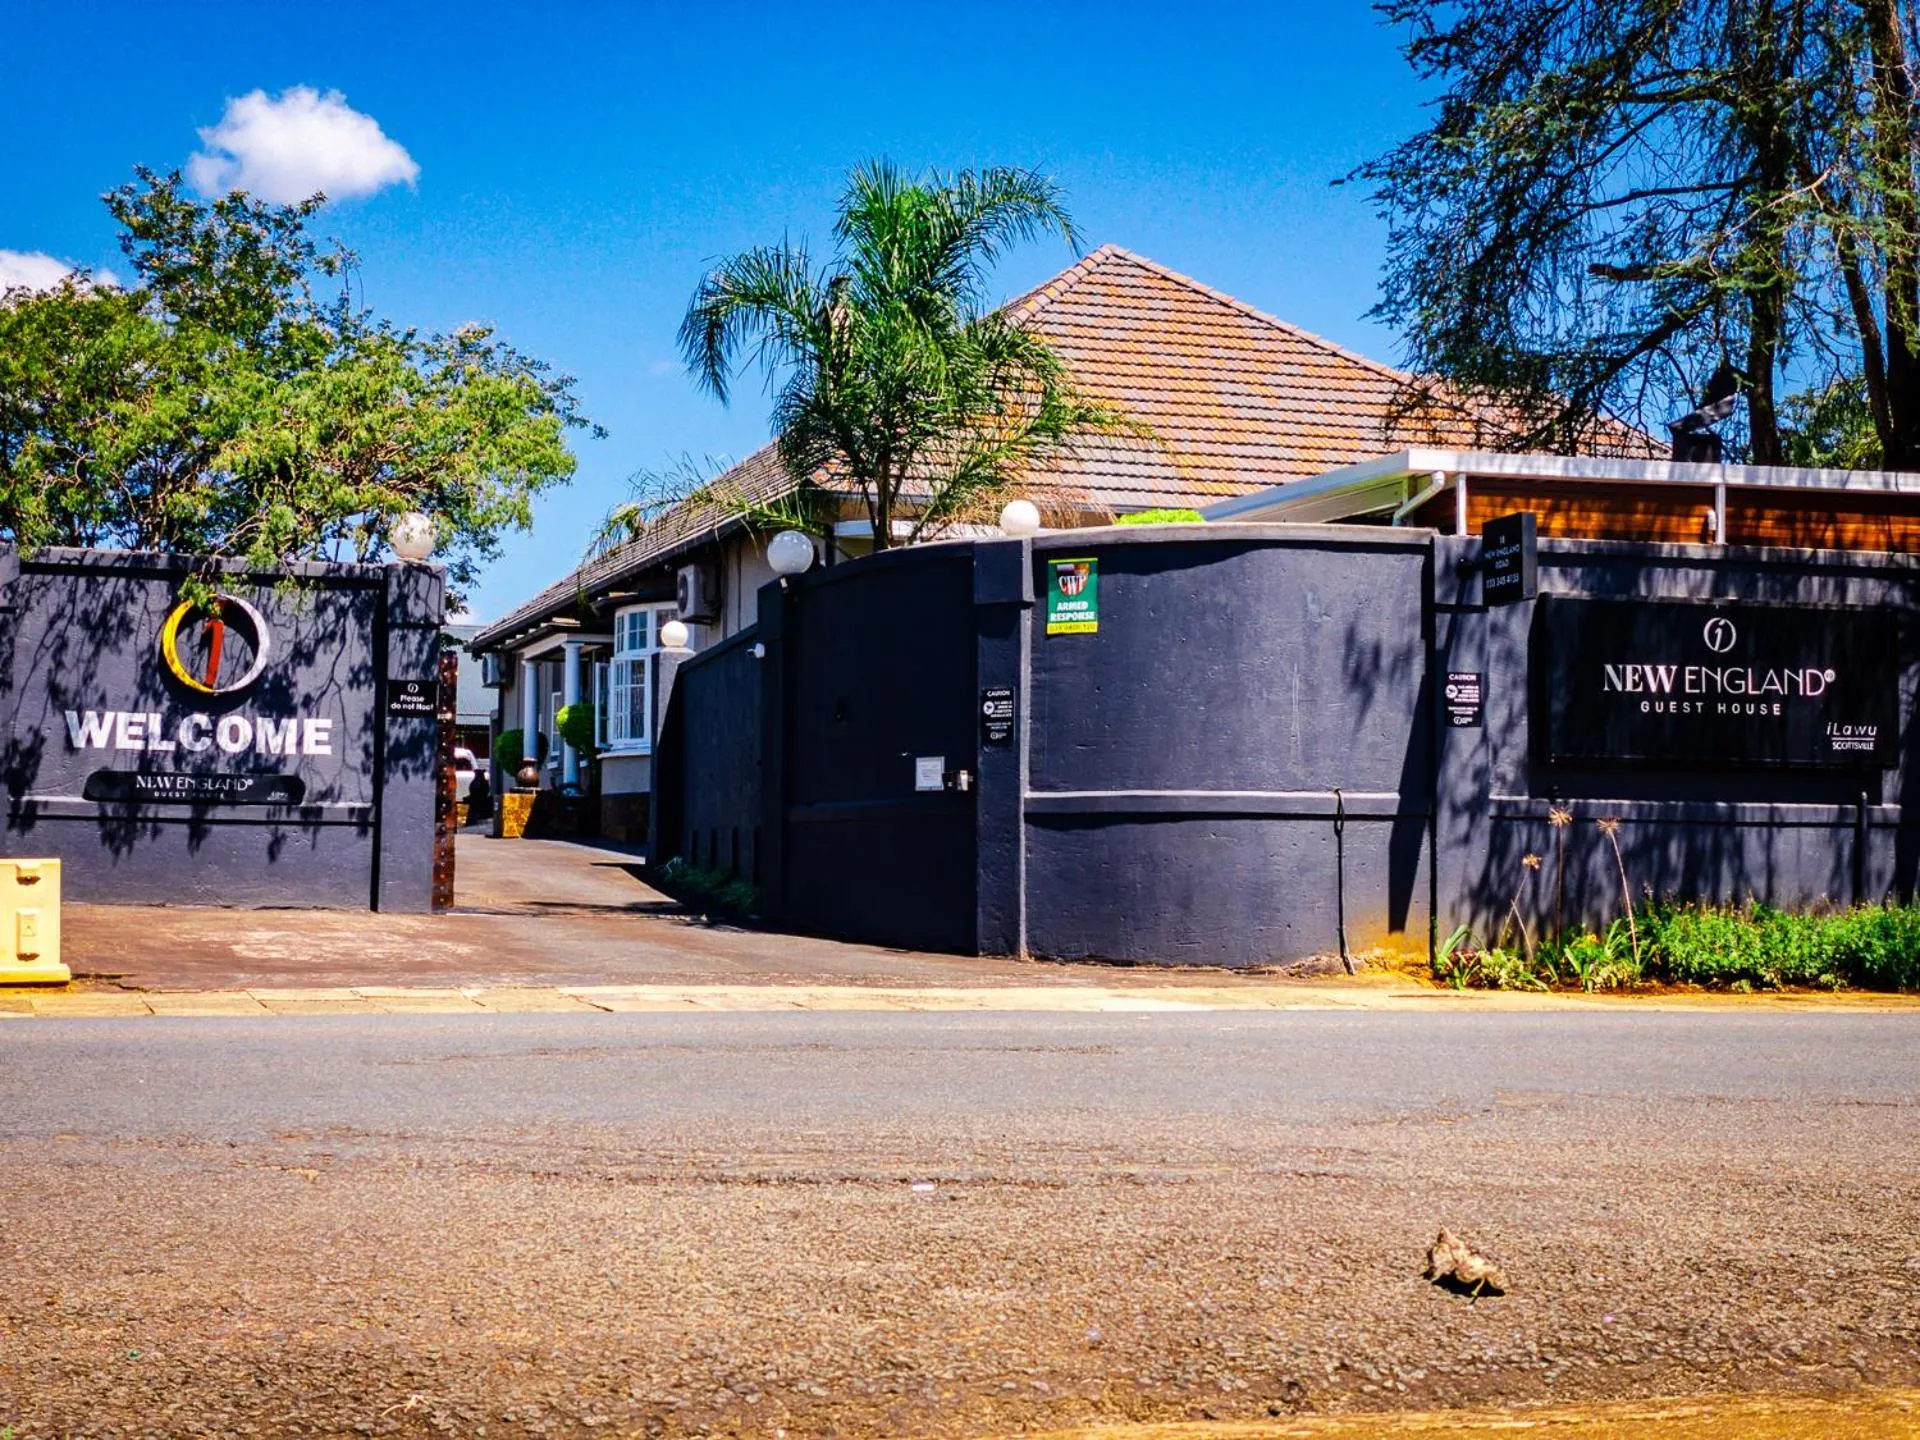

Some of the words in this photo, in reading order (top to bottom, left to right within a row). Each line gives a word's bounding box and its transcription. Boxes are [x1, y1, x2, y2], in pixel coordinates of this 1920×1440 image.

[1056, 600, 1089, 611] ARMED
[1049, 611, 1097, 622] RESPONSE
[1448, 673, 1477, 682] CAUTION
[1603, 664, 1678, 693] NEW
[1685, 666, 1826, 696] ENGLAND
[399, 694, 425, 703] Please
[986, 690, 1011, 698] CAUTION
[390, 702, 402, 710] do
[402, 702, 415, 710] not
[1640, 701, 1704, 714] GUEST
[1717, 703, 1782, 716] HOUSE
[65, 710, 333, 755] WELCOME
[1826, 721, 1878, 737] iLawu
[1832, 741, 1875, 751] SCOTTSVILLE
[175, 776, 249, 791] ENGLAND
